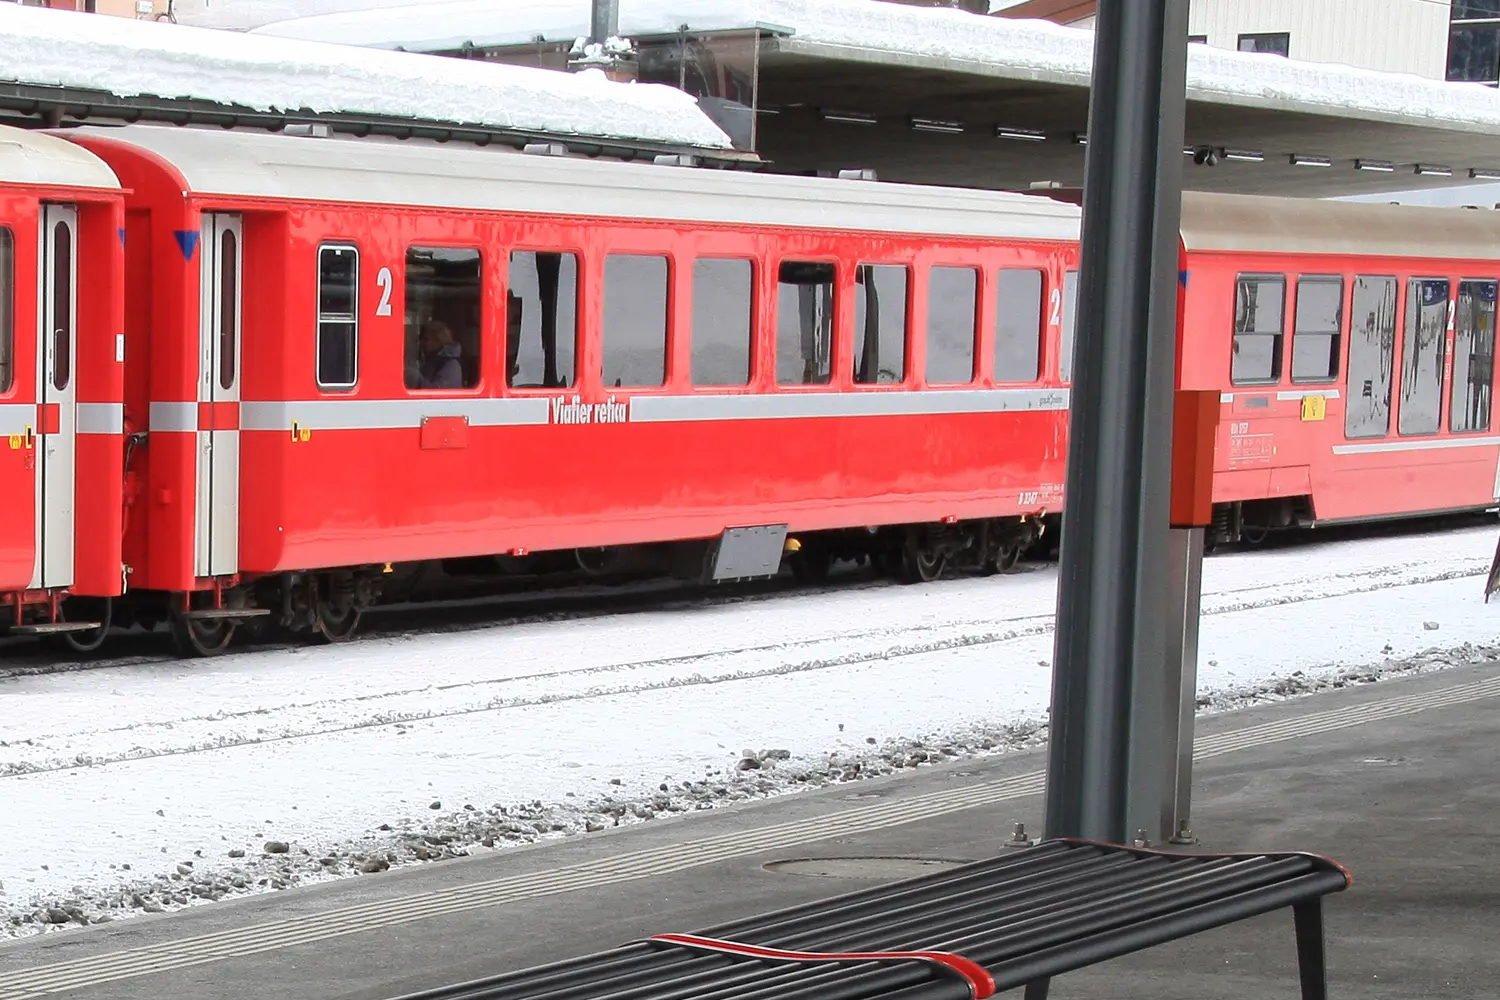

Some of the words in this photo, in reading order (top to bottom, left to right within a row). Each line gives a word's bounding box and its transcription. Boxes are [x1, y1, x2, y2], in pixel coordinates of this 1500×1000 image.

[376, 267, 392, 316] 2
[1050, 288, 1061, 326] 2
[1446, 299, 1456, 331] 2
[552, 394, 593, 425] Viafier
[594, 394, 627, 424] retica
